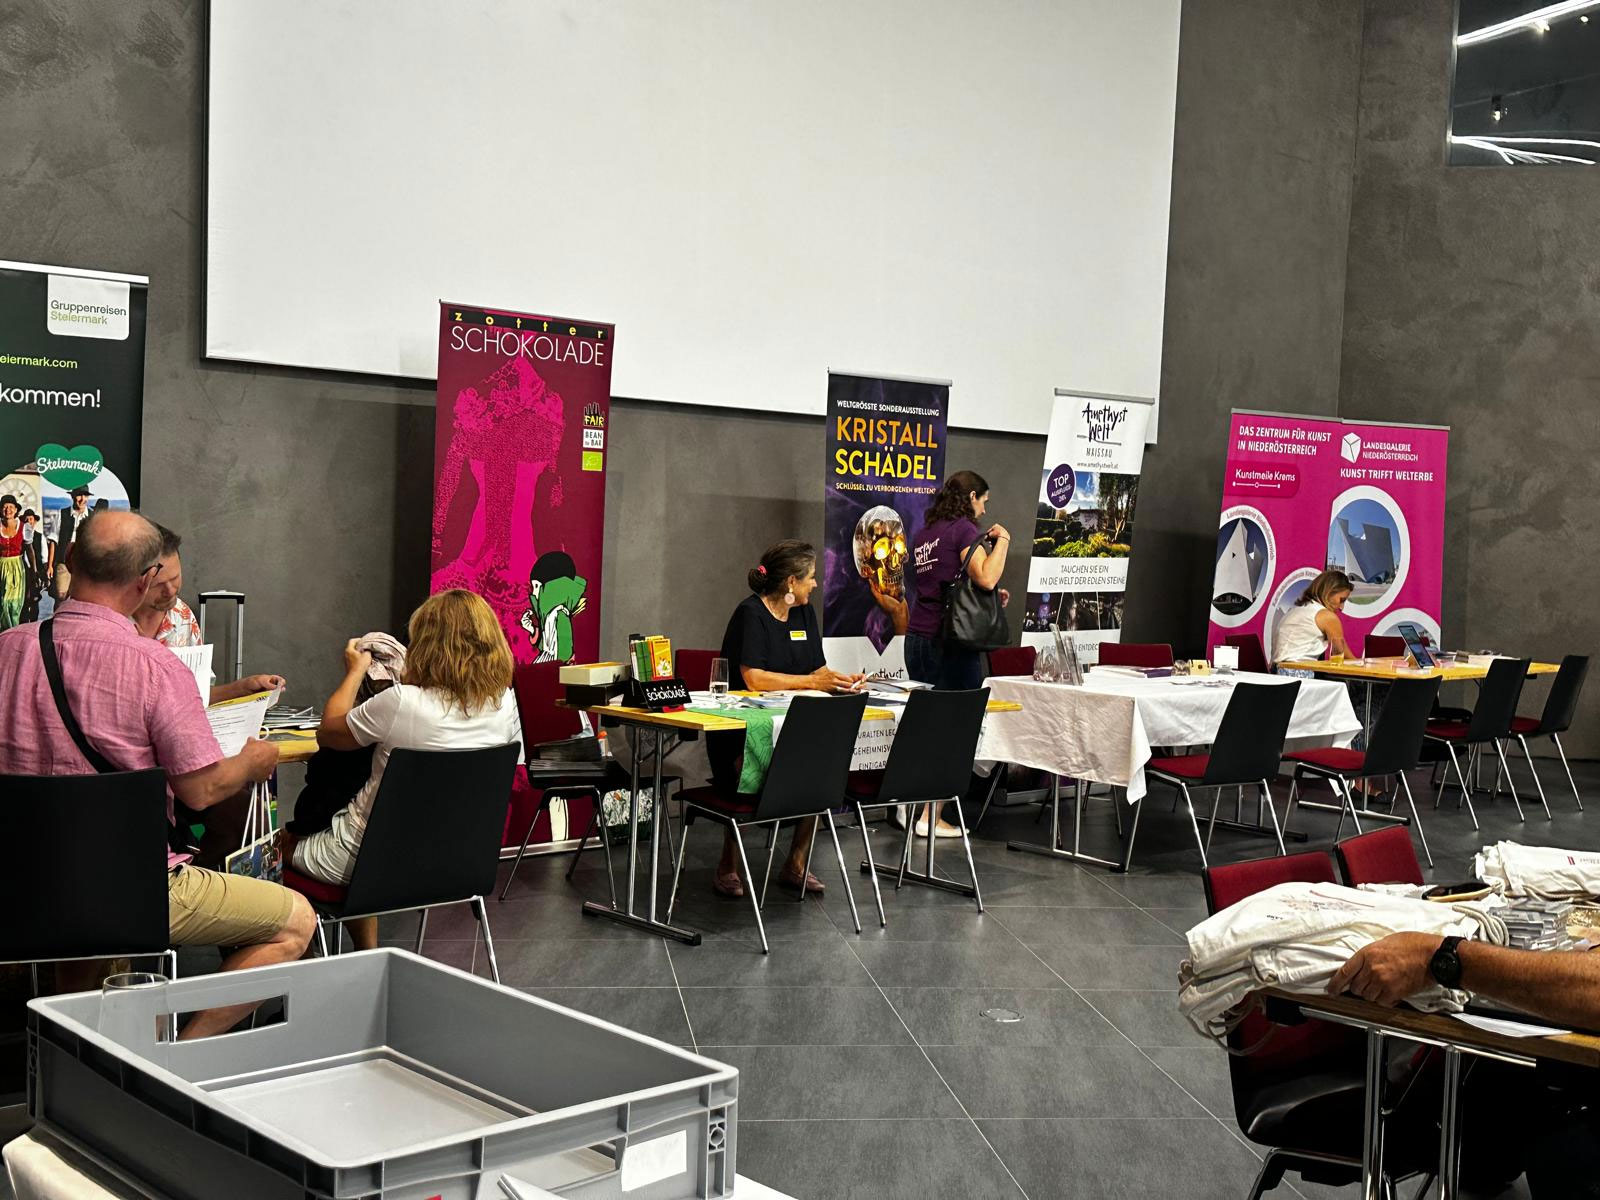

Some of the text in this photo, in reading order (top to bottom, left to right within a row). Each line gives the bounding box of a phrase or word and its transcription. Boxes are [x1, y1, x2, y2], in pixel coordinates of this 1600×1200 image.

[50, 300, 127, 316] Gruppenreisen
[50, 311, 108, 325] Steiermark
[451, 326, 604, 366] SCHOKOLADE
[836, 400, 940, 416] WELTGRÖSSTE SONDERAUSSTELLUNG
[584, 415, 604, 426] FAIR
[1082, 402, 1128, 431] Amethyst
[585, 431, 603, 439] BEAN
[837, 416, 938, 448] KRISTALL
[1088, 421, 1111, 442] Welt
[1239, 425, 1332, 442] DAS ZENTRUM FÜR KUNST
[1237, 440, 1317, 456] IN NIEDERÖSTERREICH
[1362, 441, 1411, 452] LANDESGALERIE
[835, 445, 937, 480] SCHÄDEL
[1362, 451, 1418, 462] NIEDERÖSTERREICH
[37, 457, 102, 475] Steiermark
[1053, 473, 1069, 488] TOP
[1235, 469, 1296, 482] Kunstmeile Krems
[1340, 468, 1434, 482] KUNST TRIFFT WELTERBE
[836, 482, 865, 491] SCHLÜSSEL
[1061, 564, 1109, 574] TAUCHEN SIE EIN
[1040, 577, 1048, 585] IN
[1048, 577, 1058, 585] DIE
[1058, 576, 1074, 585] WELT
[1074, 576, 1087, 585] DER
[1087, 576, 1106, 585] EDLEN
[647, 688, 687, 701] SCHOKOLADE
